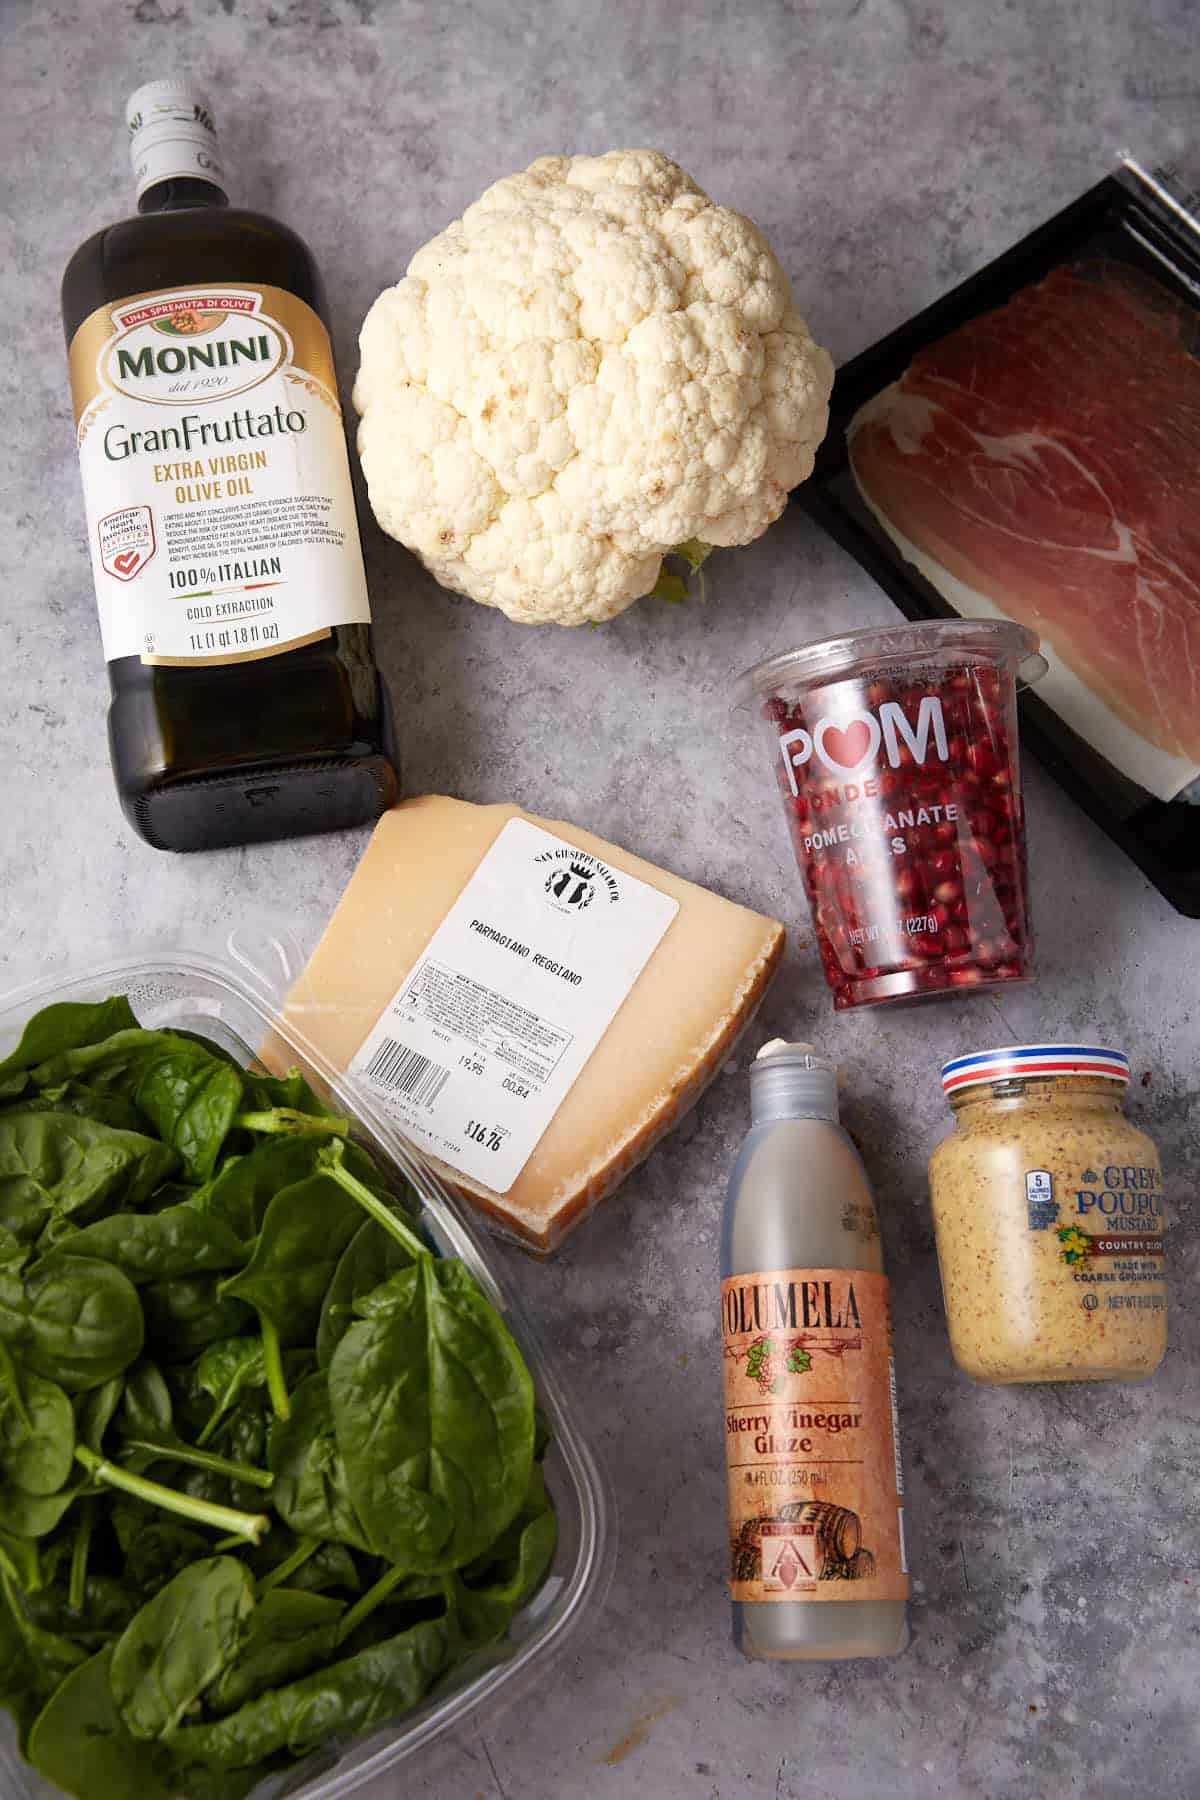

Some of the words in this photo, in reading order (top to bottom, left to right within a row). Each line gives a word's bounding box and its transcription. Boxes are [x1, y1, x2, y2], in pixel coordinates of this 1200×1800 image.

[125, 312, 146, 325] UNA
[150, 301, 203, 315] SPREMUTA
[207, 300, 218, 309] DI
[221, 300, 251, 310] OLIVE
[116, 335, 270, 379] MONINI
[168, 383, 191, 393] dal
[103, 405, 306, 461] GranFruttato
[154, 459, 205, 482] EXTRA
[208, 450, 267, 474] VIRGIN
[176, 481, 223, 504] OLIVE
[227, 476, 253, 497] OIL
[168, 567, 217, 589] 100%
[218, 557, 282, 582] ITALIAN
[186, 606, 212, 621] COLD
[215, 597, 274, 616] EXTRACTION
[218, 630, 231, 648] qt
[233, 627, 248, 645] 1.8
[262, 622, 279, 640] oz)
[534, 852, 553, 862] SAN
[555, 849, 594, 865] GIUSEPPE
[906, 915, 938, 937] (227g)
[469, 919, 531, 958] PARMAGIANO
[531, 953, 583, 986] REGGIANO
[458, 1055, 485, 1076] 19.95
[502, 1078, 529, 1099] 00.84
[464, 1120, 503, 1151] $16.76
[1035, 1174, 1043, 1187] 5
[1098, 1241, 1143, 1251] COUNTRY
[1074, 1273, 1116, 1281] COARSE
[727, 1414, 772, 1435] Sherry
